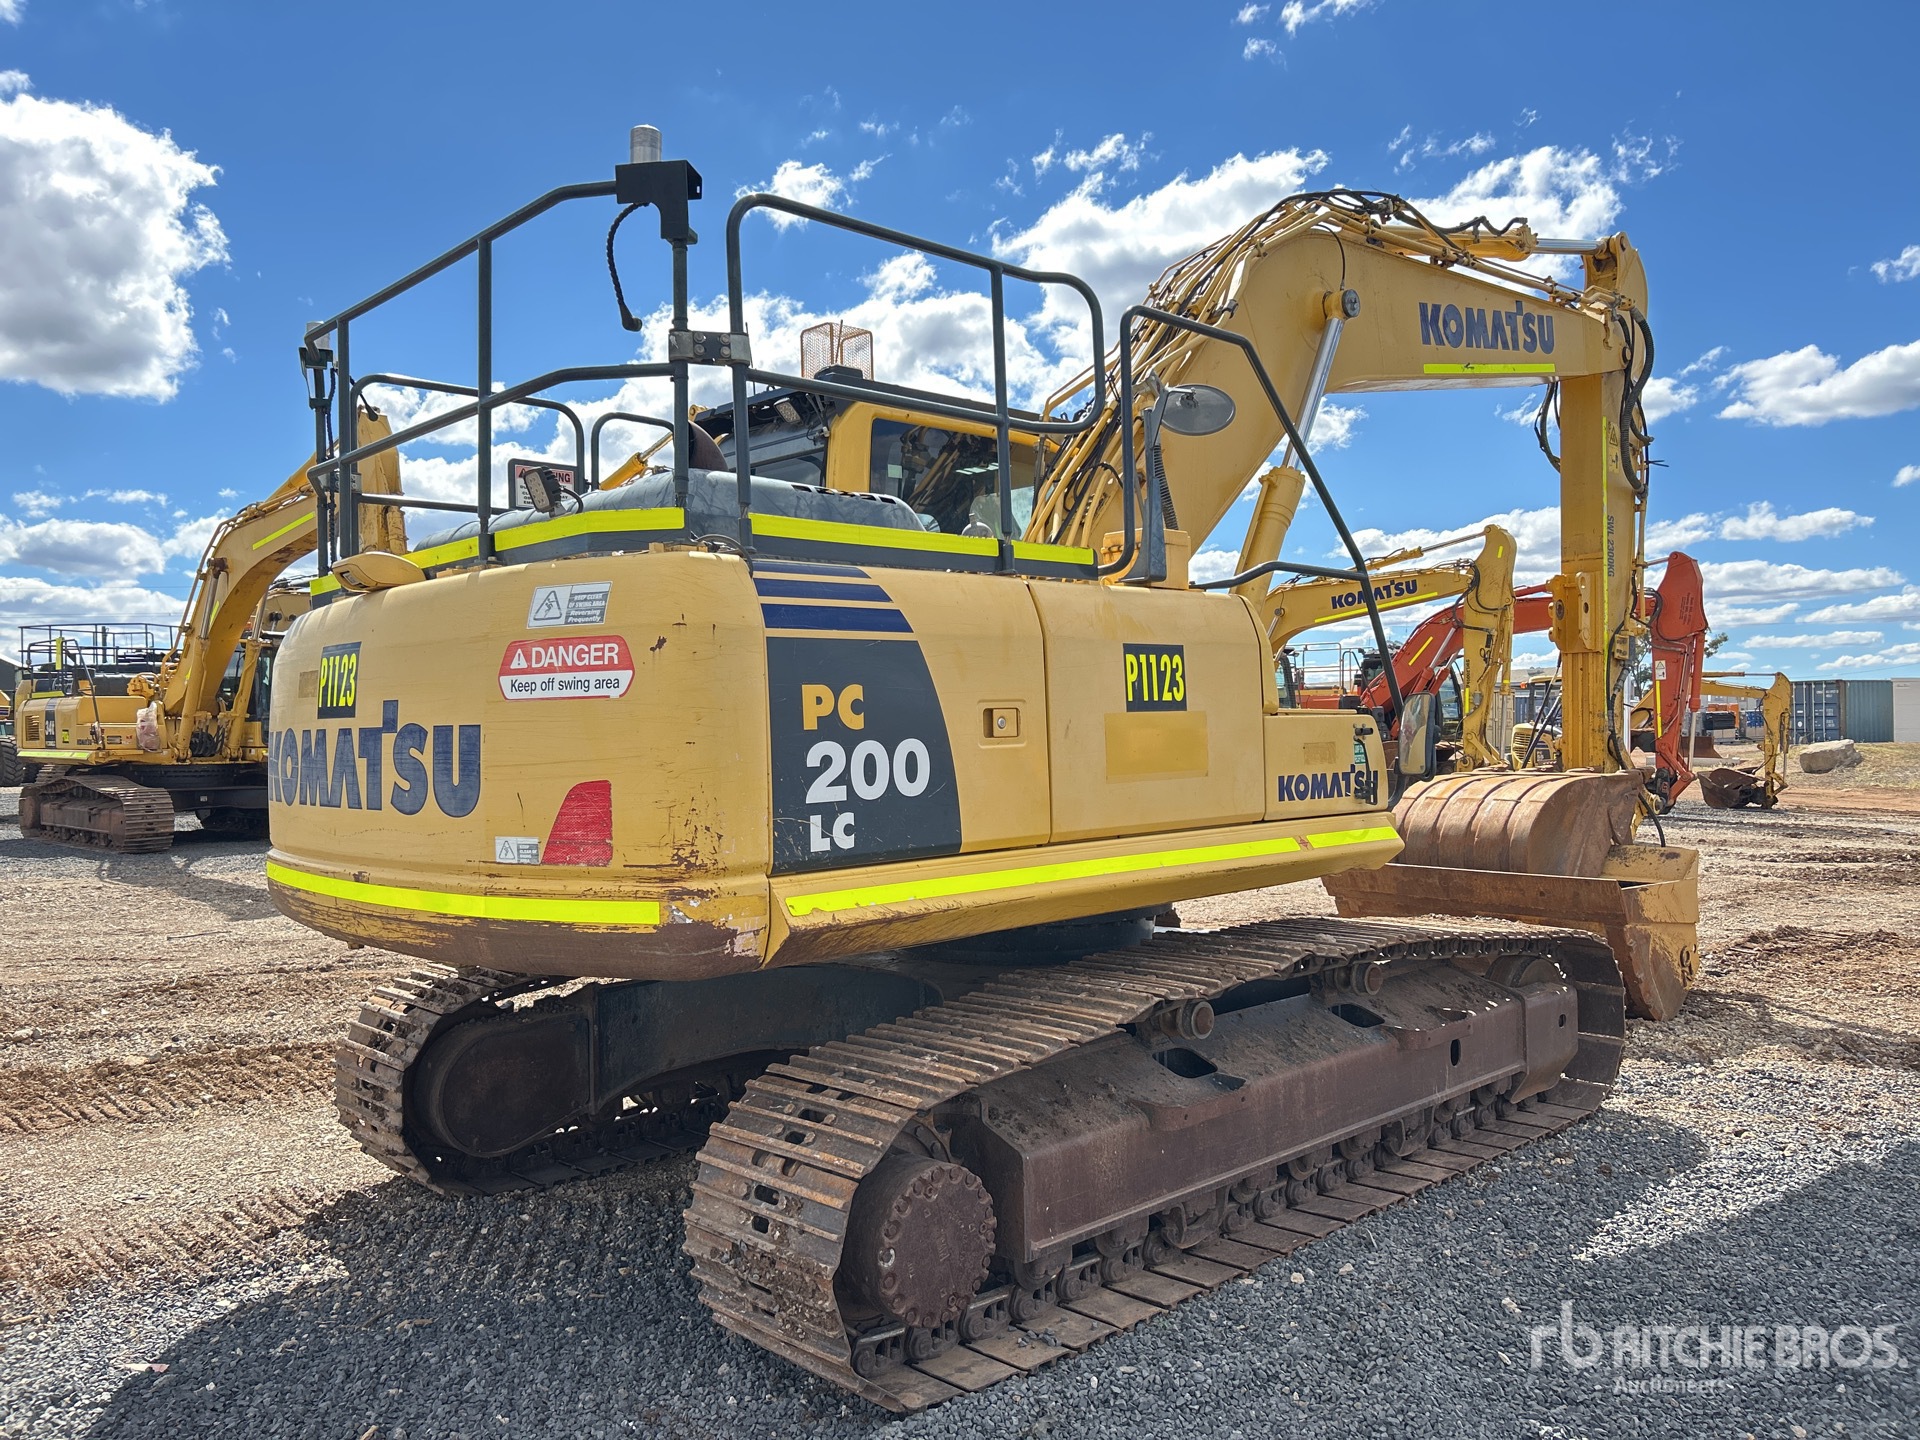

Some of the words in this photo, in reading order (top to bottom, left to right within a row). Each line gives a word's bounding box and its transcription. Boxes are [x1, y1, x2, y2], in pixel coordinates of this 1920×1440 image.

[1418, 300, 1556, 355] KOMATSU
[1607, 515, 1615, 537] SWL
[567, 615, 602, 623] Frequently
[531, 643, 619, 668] DANGER
[1125, 654, 1184, 702] P1123
[319, 653, 357, 707] P1123
[510, 679, 537, 695] Keep
[540, 677, 555, 692] off
[558, 676, 590, 692] swing
[594, 678, 620, 689] area
[802, 684, 864, 730] PC
[269, 699, 481, 818] KOMATSU
[805, 738, 931, 804] 200
[810, 812, 855, 852] LC
